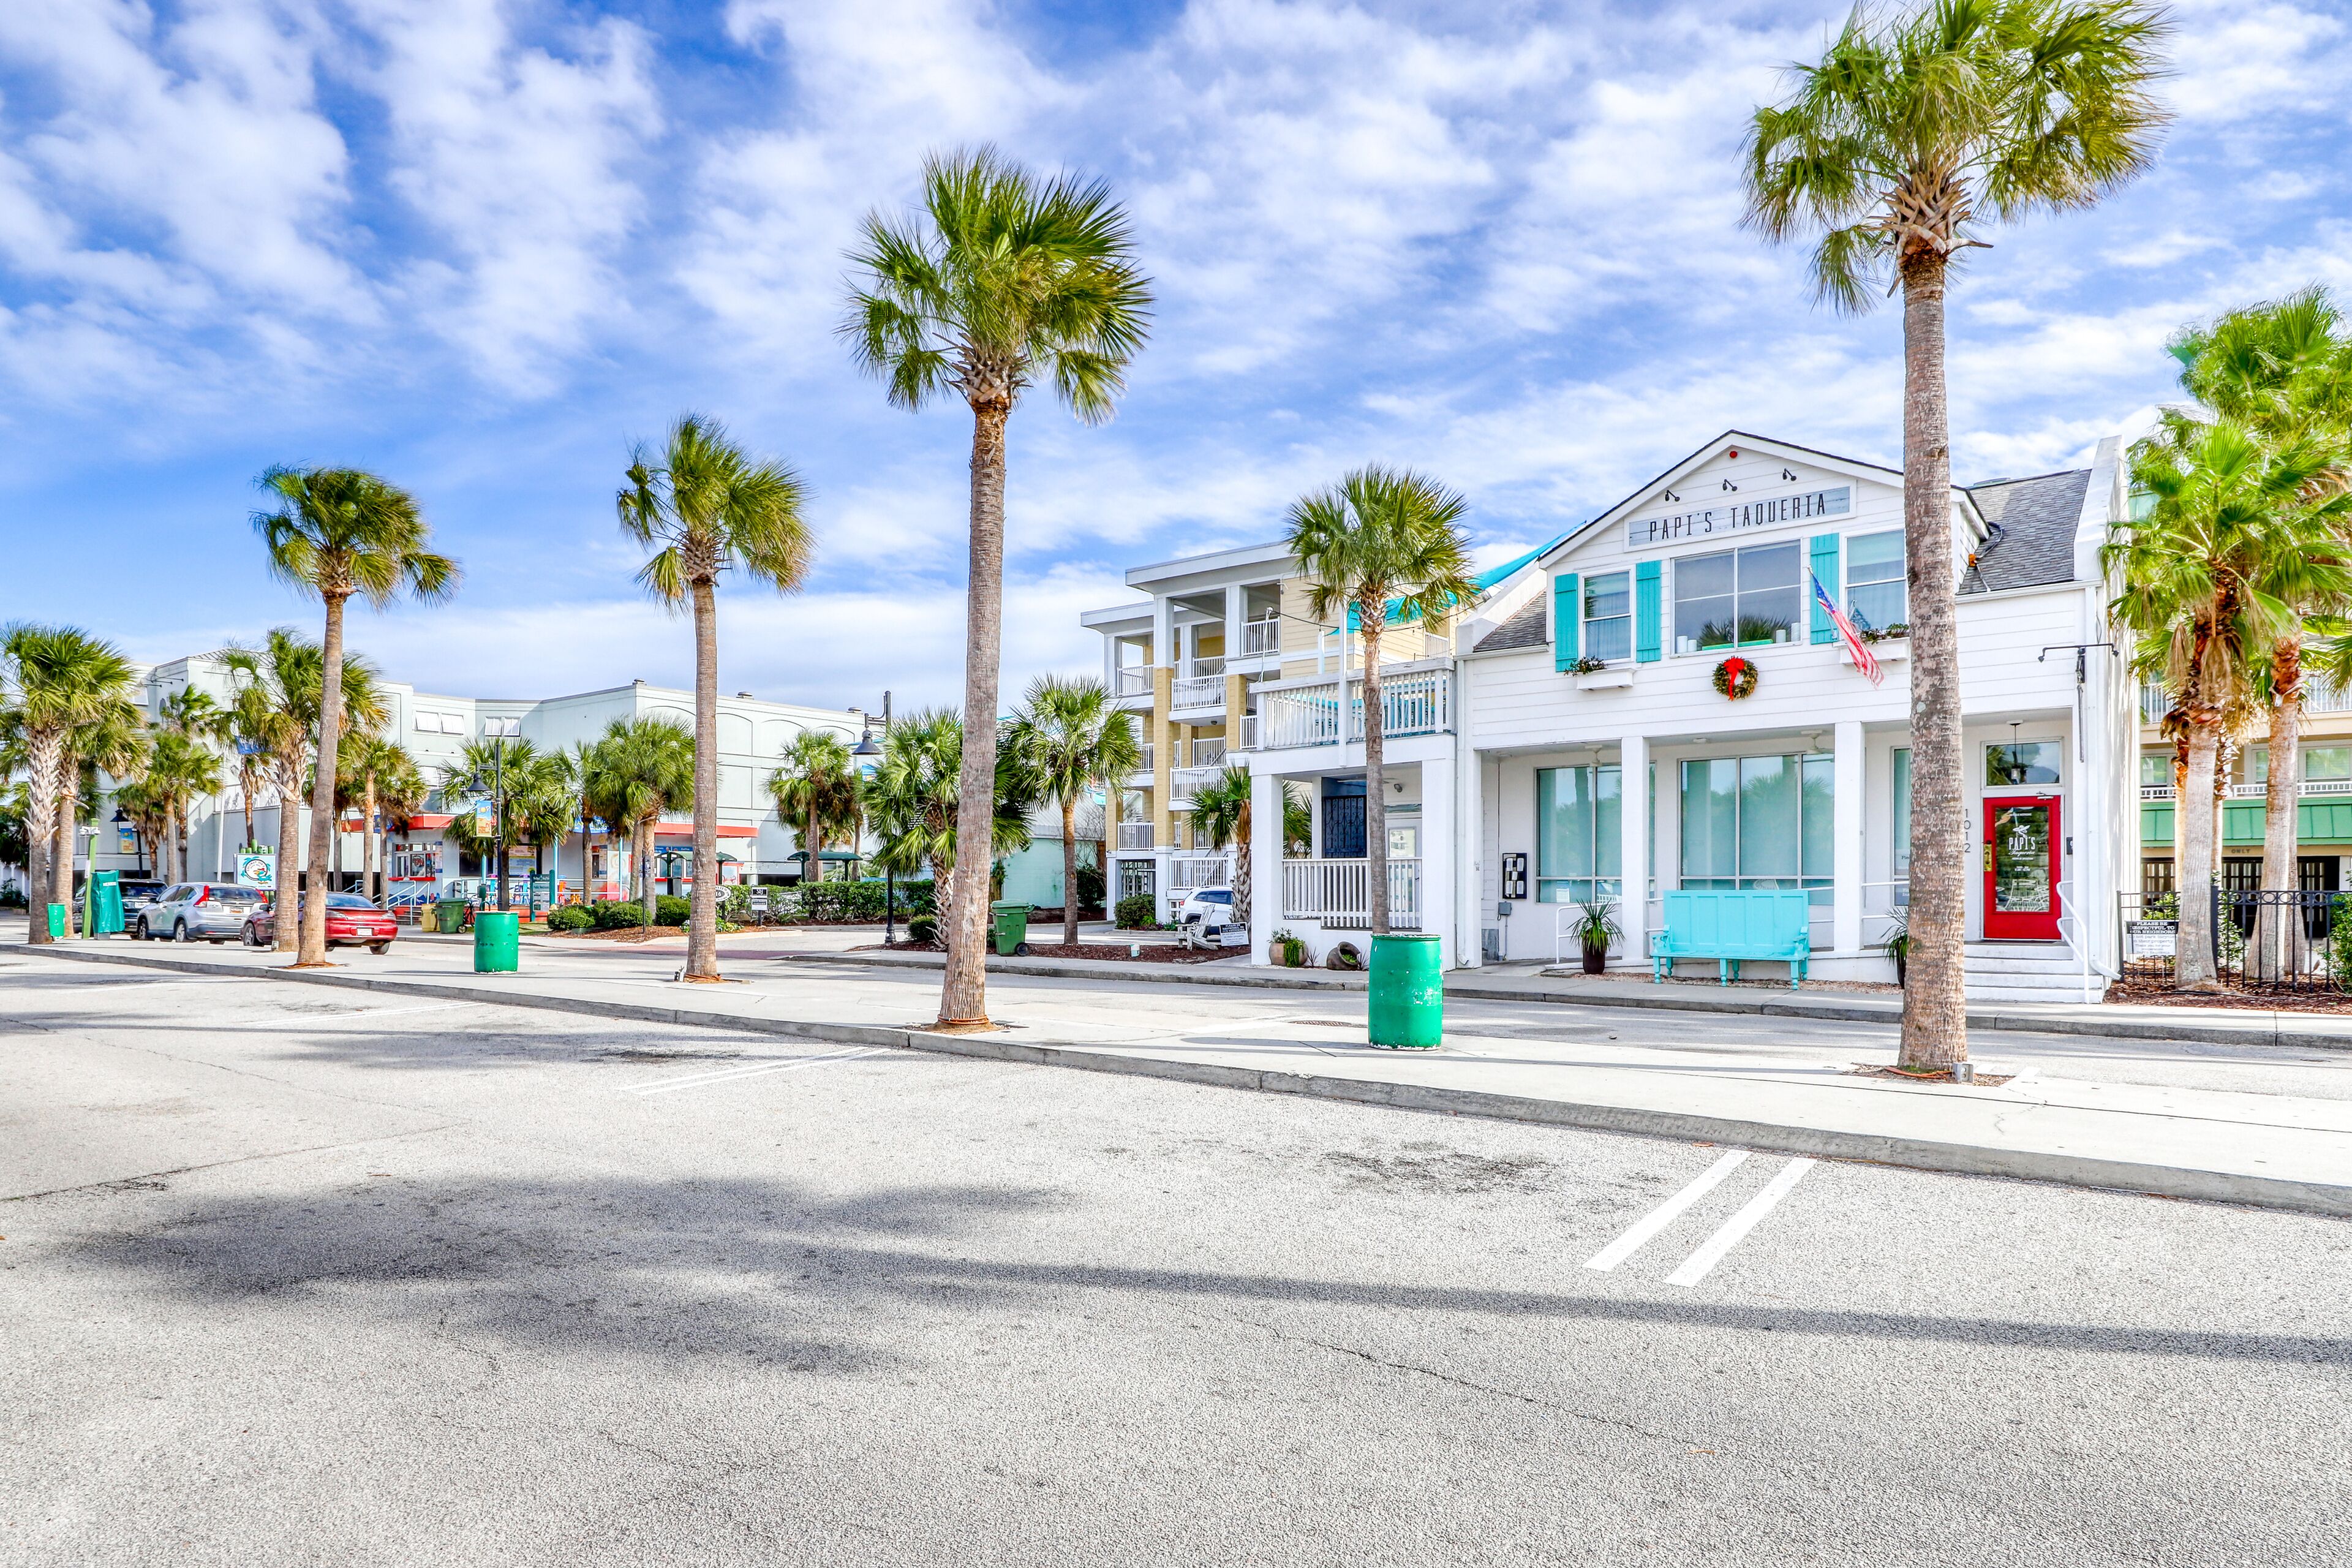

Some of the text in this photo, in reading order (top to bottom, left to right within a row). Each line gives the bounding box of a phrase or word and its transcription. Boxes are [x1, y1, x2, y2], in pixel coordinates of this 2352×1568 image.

[1649, 493, 1826, 541] PAPI'S TAQUERIA
[2009, 837, 2035, 850] PAPI'S
[2008, 848, 2035, 857] Taqueria
